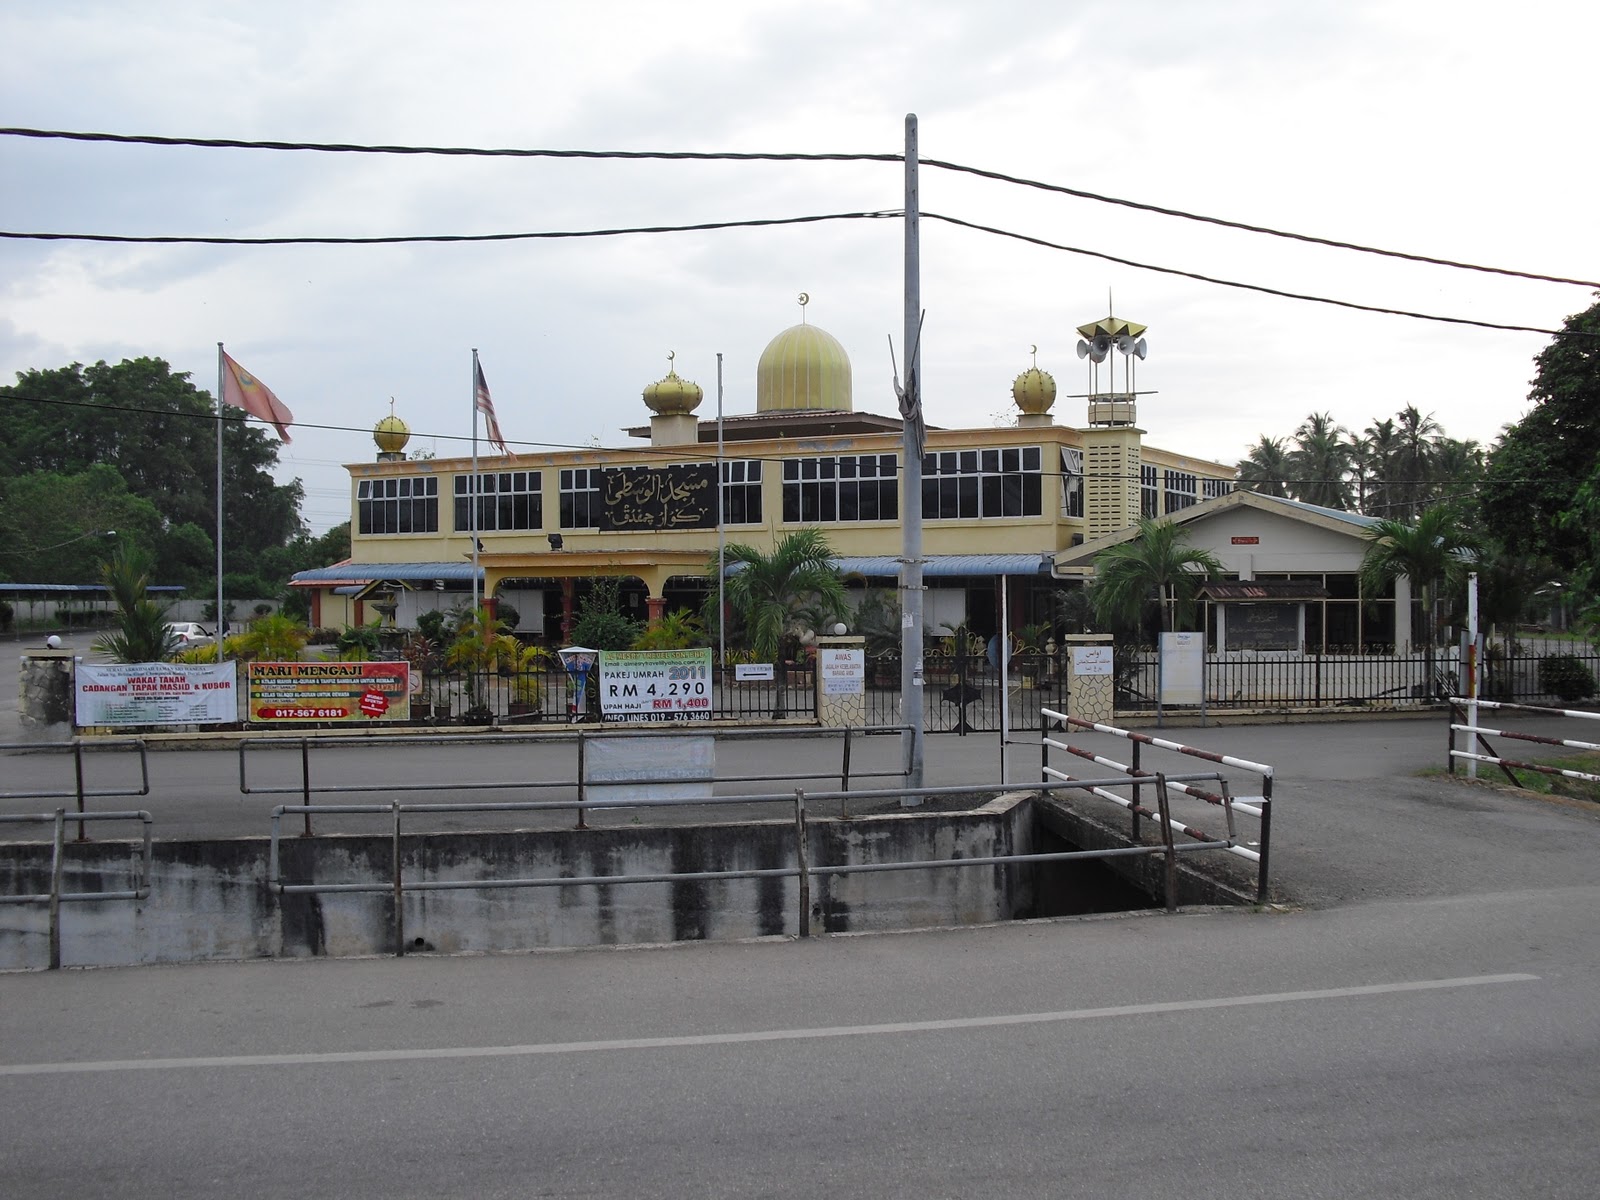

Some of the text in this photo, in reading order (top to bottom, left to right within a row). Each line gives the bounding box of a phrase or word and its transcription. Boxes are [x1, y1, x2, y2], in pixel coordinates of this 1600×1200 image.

[641, 652, 670, 660] TRAVEL
[834, 653, 852, 661] AWAS
[254, 665, 363, 676] MARI MENGAJI
[604, 665, 706, 680] PAKEJ UMRAH 2011
[127, 676, 157, 684] WAKAF
[82, 684, 128, 692] CADANGAN
[132, 684, 158, 692] TAPAK
[160, 683, 190, 691] MASJID
[202, 681, 231, 690] KUBUR
[609, 682, 705, 698] RM 4,290
[652, 699, 672, 709] RM
[674, 698, 709, 710] 1,400
[275, 709, 316, 717] 017-567
[650, 713, 666, 721] 019
[673, 712, 688, 720] 576
[690, 711, 710, 720] 3660
